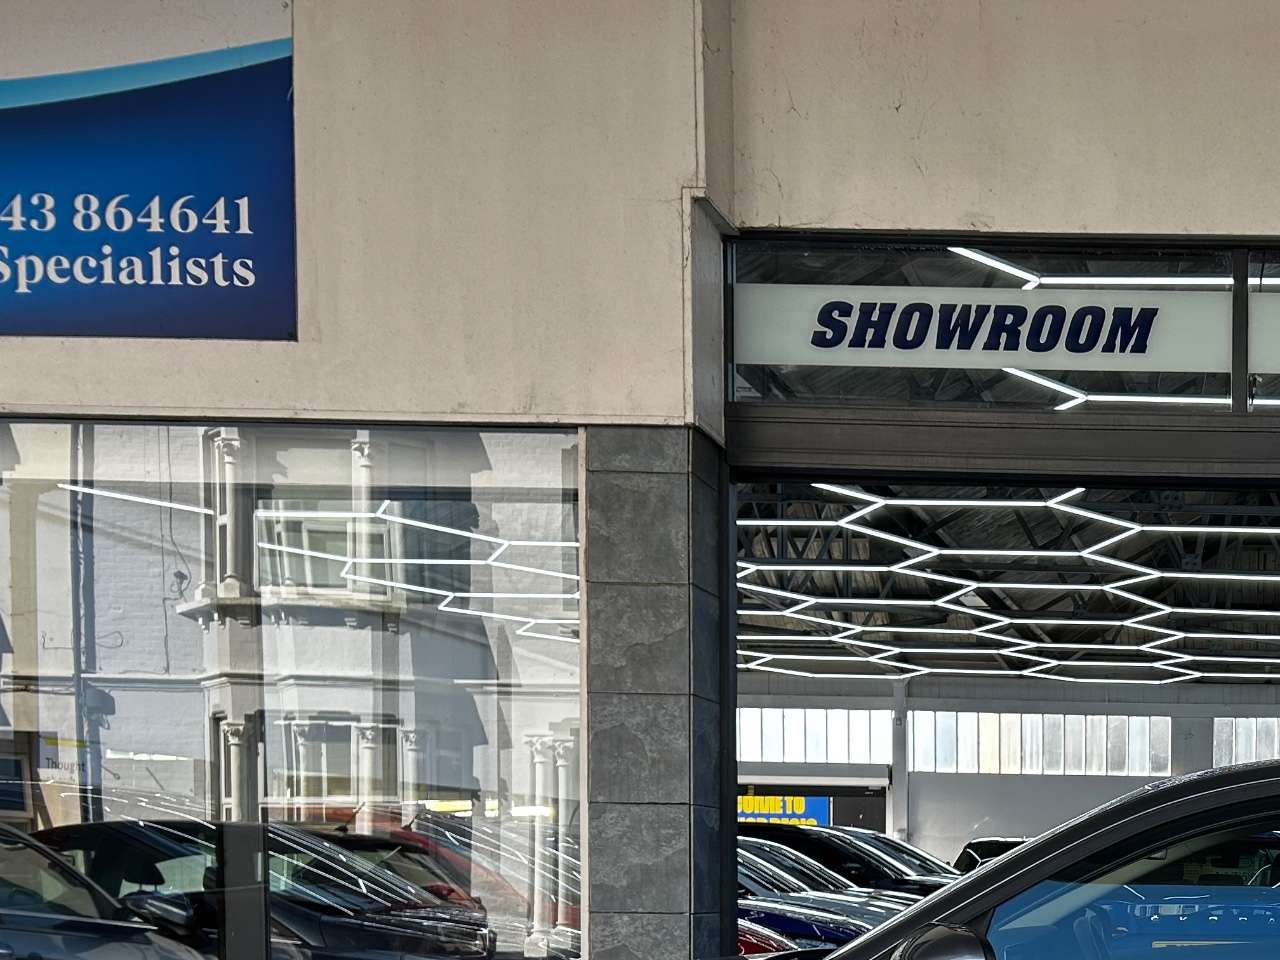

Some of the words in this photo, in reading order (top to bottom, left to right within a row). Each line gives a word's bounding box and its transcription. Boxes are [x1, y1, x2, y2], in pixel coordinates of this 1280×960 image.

[0, 192, 57, 232] 43
[72, 193, 254, 235] 864641
[810, 300, 1160, 355] SHOWROOM
[784, 796, 806, 815] TO
